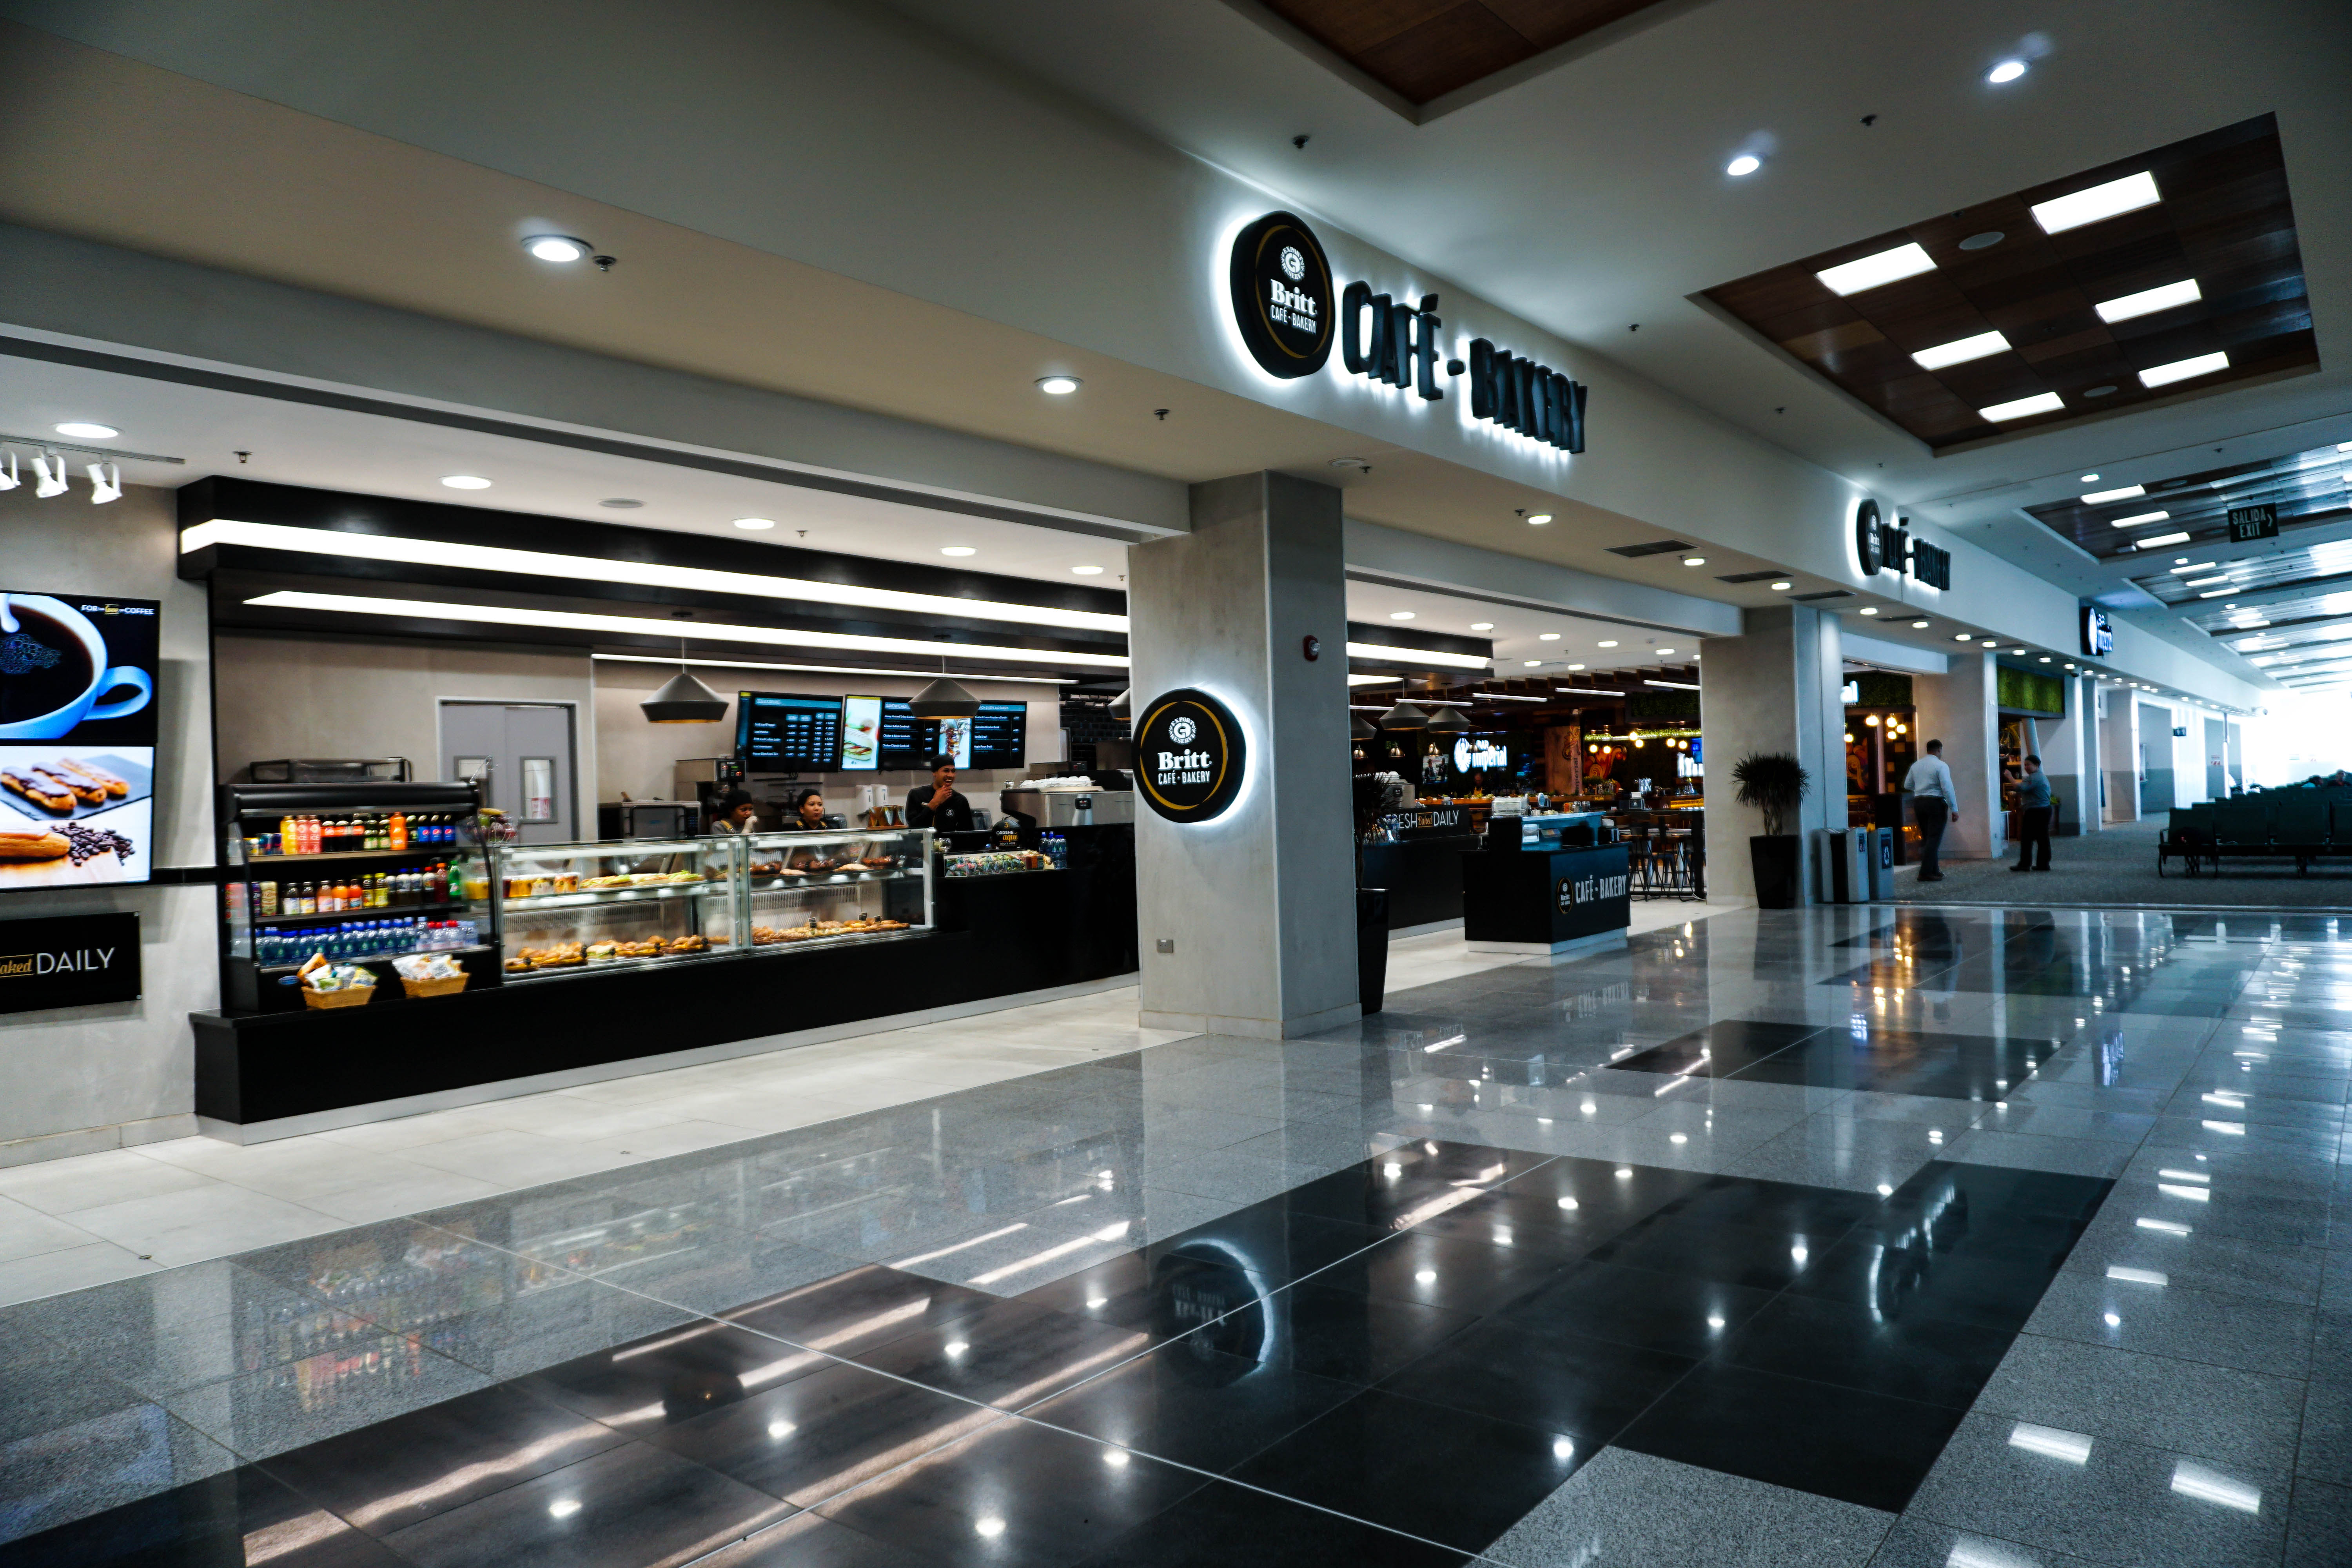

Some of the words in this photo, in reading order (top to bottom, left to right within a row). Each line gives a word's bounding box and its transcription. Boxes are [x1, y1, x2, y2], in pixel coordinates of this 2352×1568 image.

[1270, 279, 1316, 315] Britt
[1271, 305, 1288, 323] CAFÉ
[1292, 313, 1316, 333] BAKERY
[1342, 280, 1444, 401] CAFÉ
[1469, 337, 1587, 454] BAKERY
[2232, 507, 2267, 525] SALIDA
[1870, 532, 1880, 545] Britt
[2239, 522, 2260, 538] EXIT
[1171, 717, 1195, 726] EXPORT
[1170, 733, 1196, 744] RESERVE
[1476, 740, 1489, 750] BAR
[1158, 749, 1210, 770] Britt
[1158, 770, 1176, 784] CAFÉ
[1182, 771, 1210, 783] BAKERY
[1417, 815, 1433, 826] Baked
[1433, 810, 1459, 826] DAILY
[1575, 875, 1594, 904] CAFÉ
[1599, 875, 1626, 899] BAKERY
[0, 958, 33, 975] aked
[36, 947, 116, 975] DAILY
